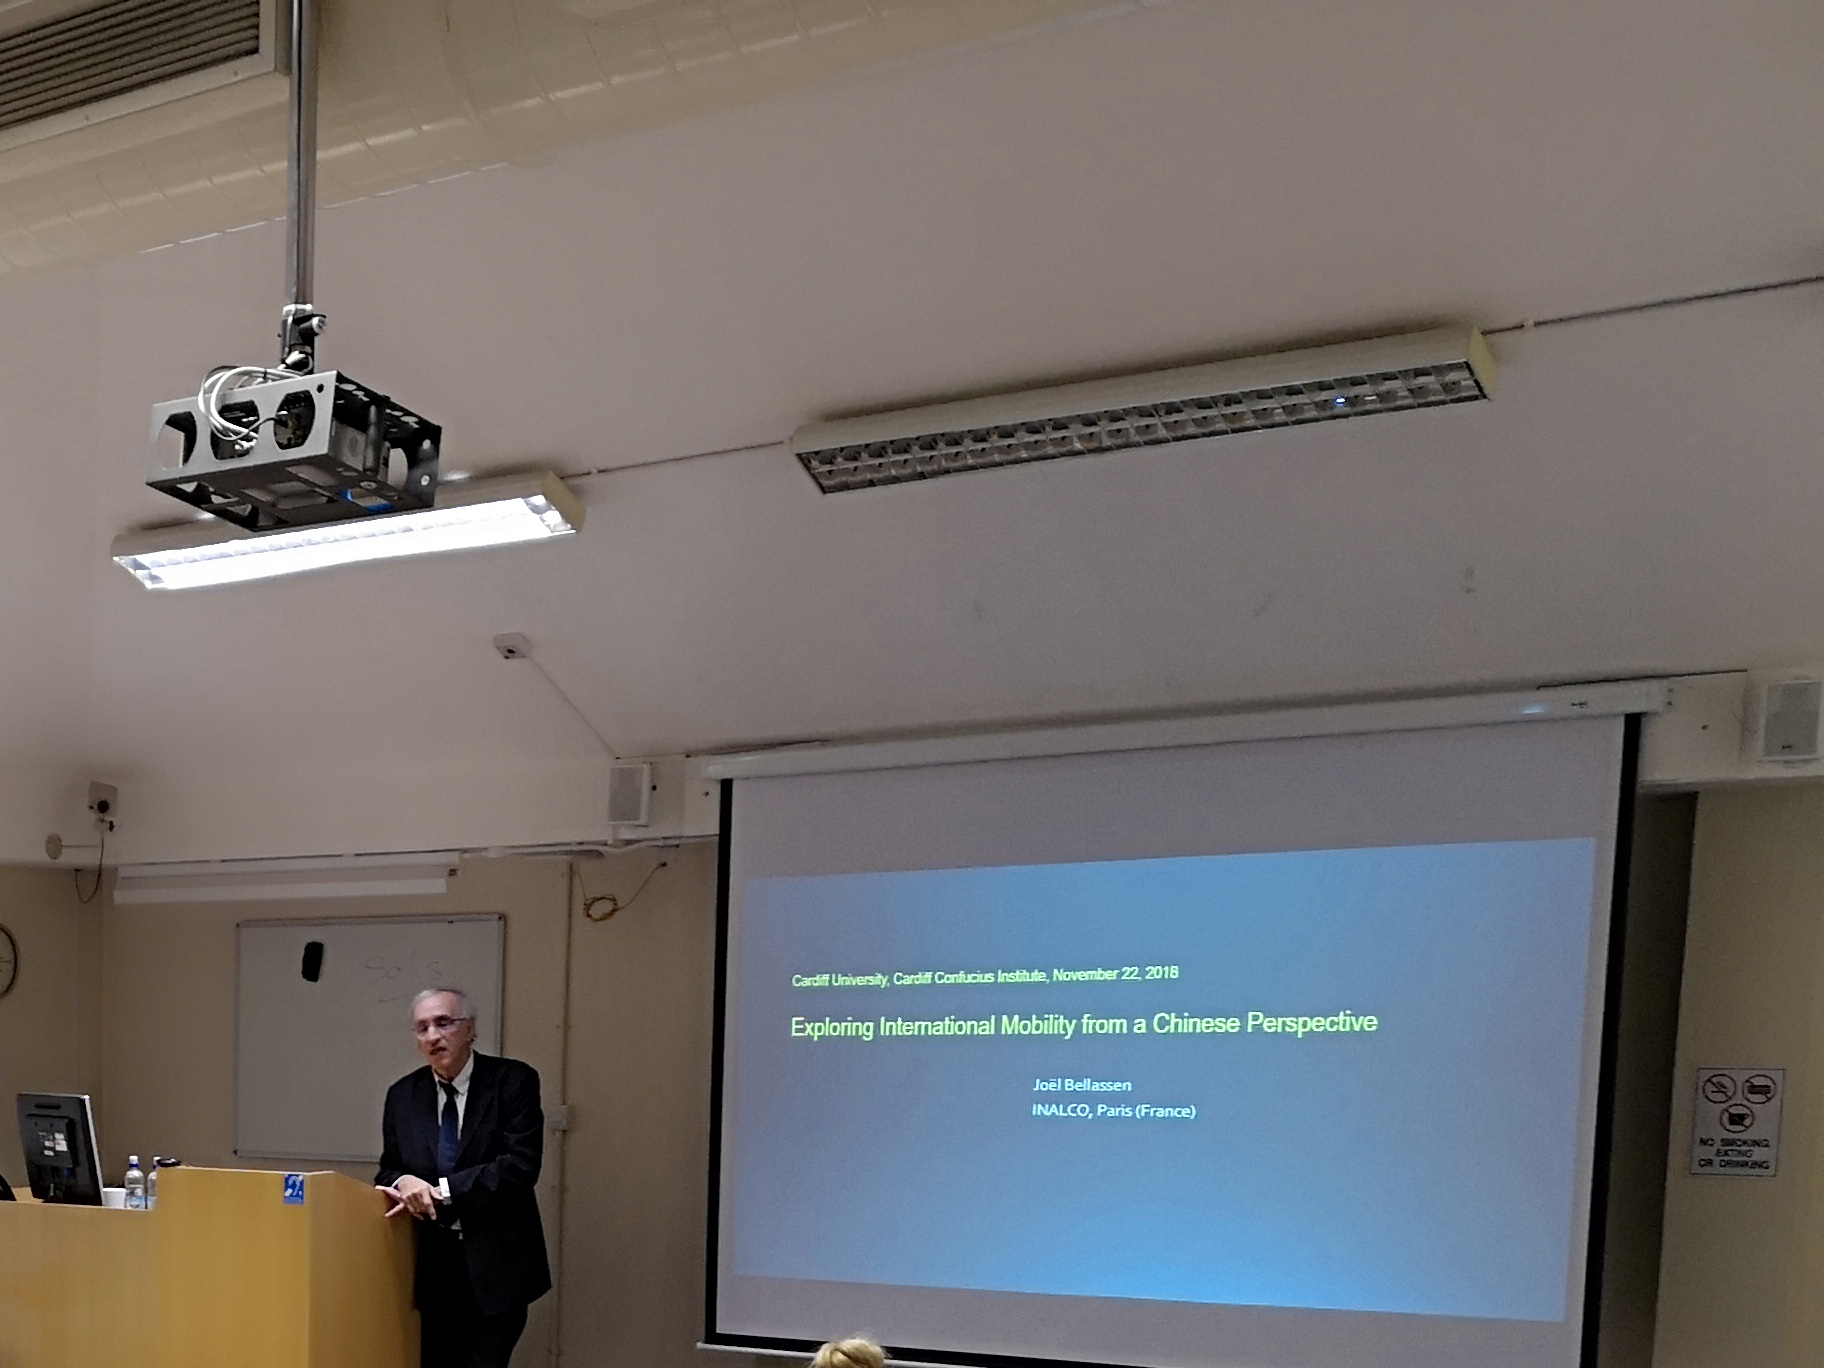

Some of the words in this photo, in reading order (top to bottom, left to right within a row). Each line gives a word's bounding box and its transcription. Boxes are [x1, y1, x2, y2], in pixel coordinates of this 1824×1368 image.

[792, 973, 830, 987] Cardiff
[832, 972, 890, 989] University,
[893, 971, 934, 985] Cardiff
[935, 970, 995, 985] Confucius
[998, 969, 1050, 984] Institute,
[1052, 967, 1119, 982] November
[1121, 966, 1142, 982] 22,
[1145, 965, 1179, 980] 2018
[791, 1016, 874, 1042] Exploring
[880, 1015, 995, 1036] International
[1001, 1014, 1076, 1040] Mobility
[1081, 1013, 1127, 1035] from
[1133, 1018, 1147, 1034] a
[1153, 1011, 1241, 1034] Chinese
[1247, 1010, 1378, 1039] Perspective
[1033, 1078, 1062, 1092] Joël
[1064, 1078, 1133, 1092] Bellassen
[1032, 1103, 1094, 1120] INALCO,
[1097, 1103, 1133, 1118] Paris
[1135, 1104, 1197, 1120] (France)
[1699, 1137, 1715, 1147] NO
[1698, 1158, 1714, 1168] OR
